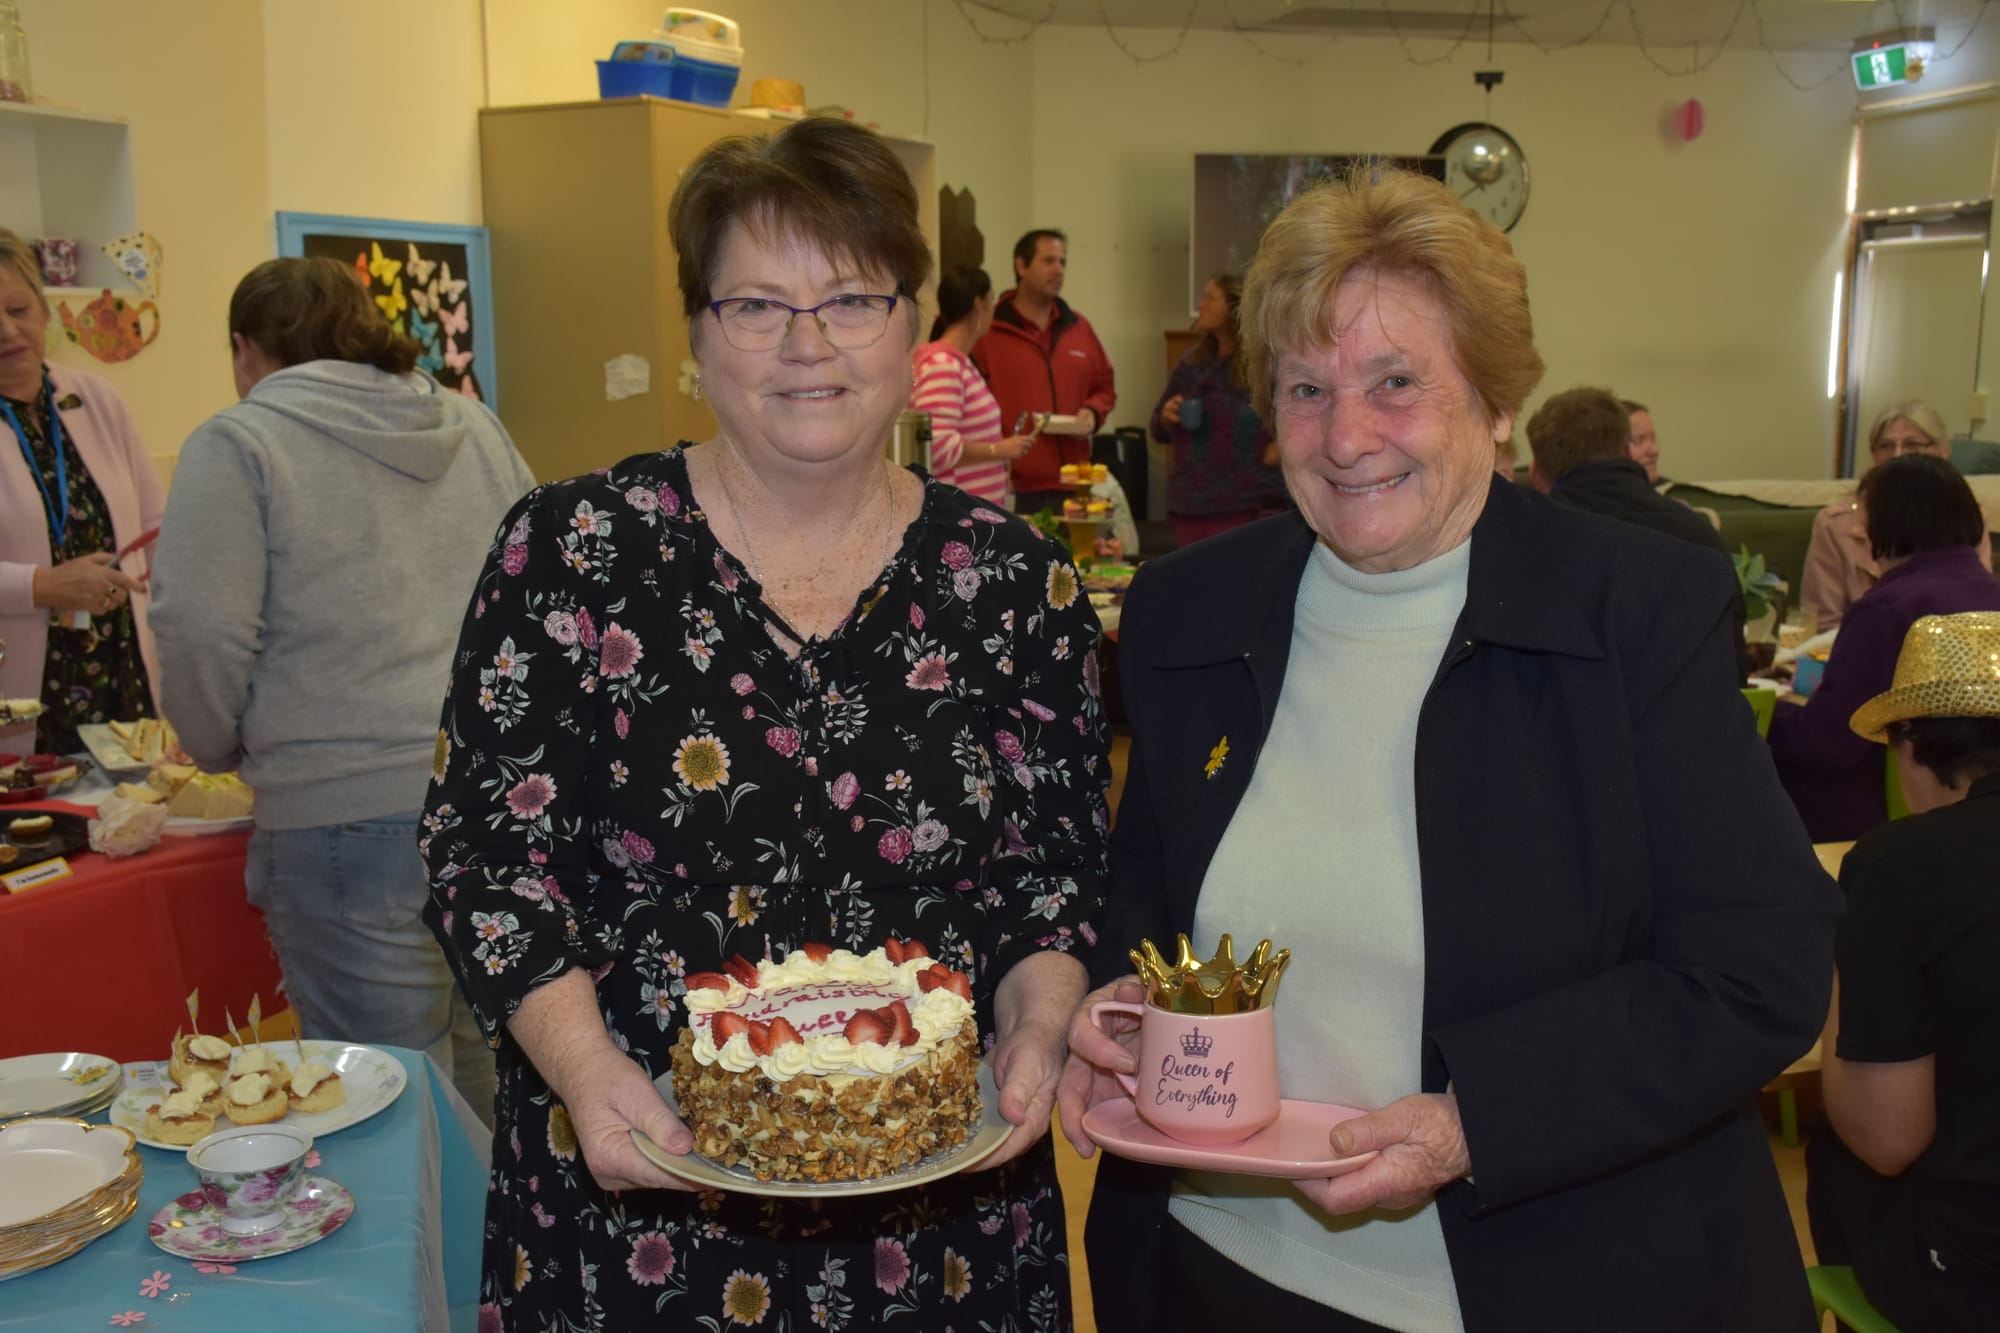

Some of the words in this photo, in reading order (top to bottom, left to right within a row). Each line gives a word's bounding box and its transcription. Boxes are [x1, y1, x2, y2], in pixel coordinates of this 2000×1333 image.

[1161, 1054, 1211, 1081] Queen
[1215, 1061, 1234, 1085] of
[1156, 1077, 1239, 1118] Everything
